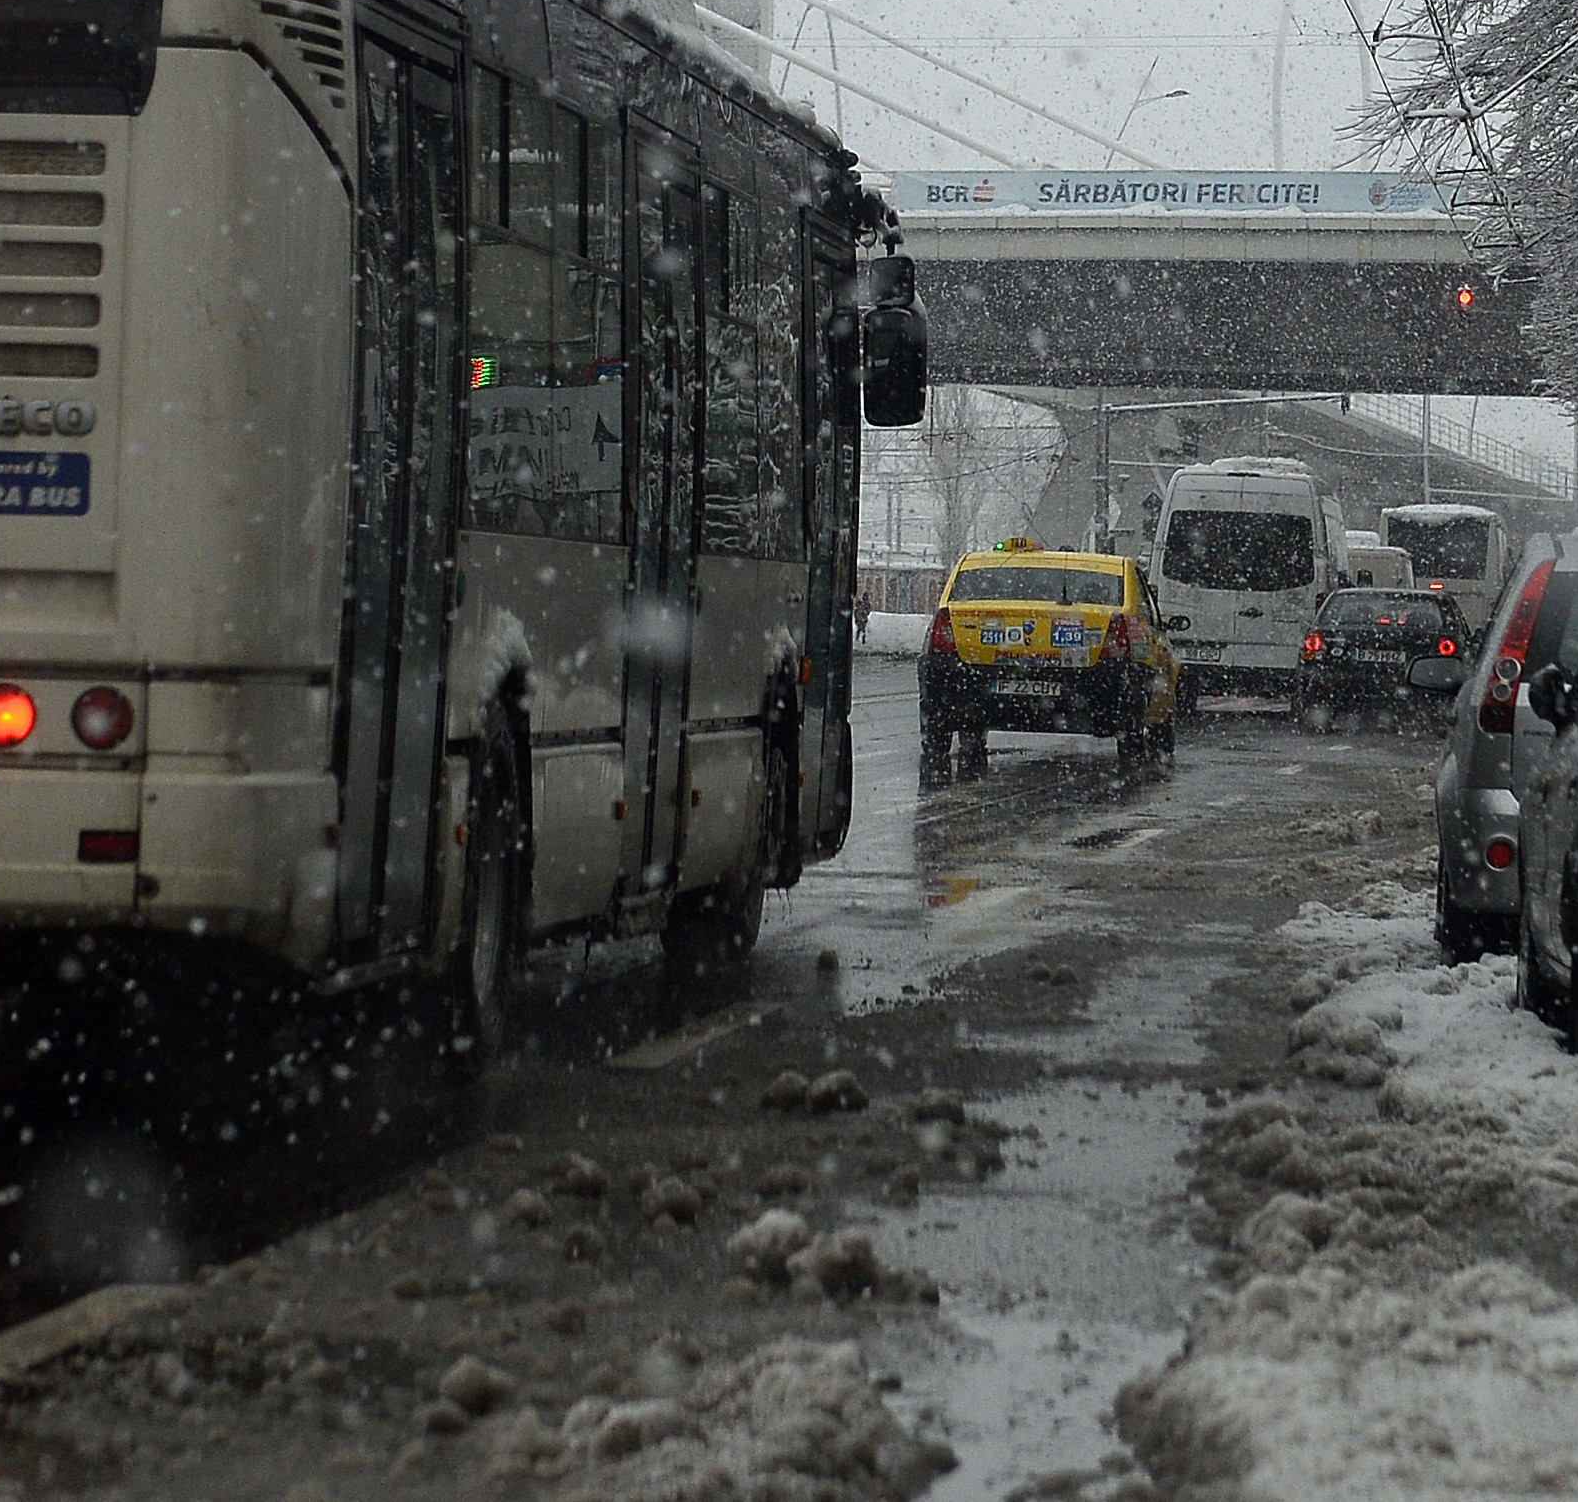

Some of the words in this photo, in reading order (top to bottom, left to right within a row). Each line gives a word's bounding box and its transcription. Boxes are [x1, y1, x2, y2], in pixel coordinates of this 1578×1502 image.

[927, 184, 969, 203] BCR
[1038, 179, 1187, 204] SĂRBĂTORI
[27, 486, 82, 507] BUS
[982, 630, 1004, 644] 2511
[1052, 631, 1082, 643] 1,39
